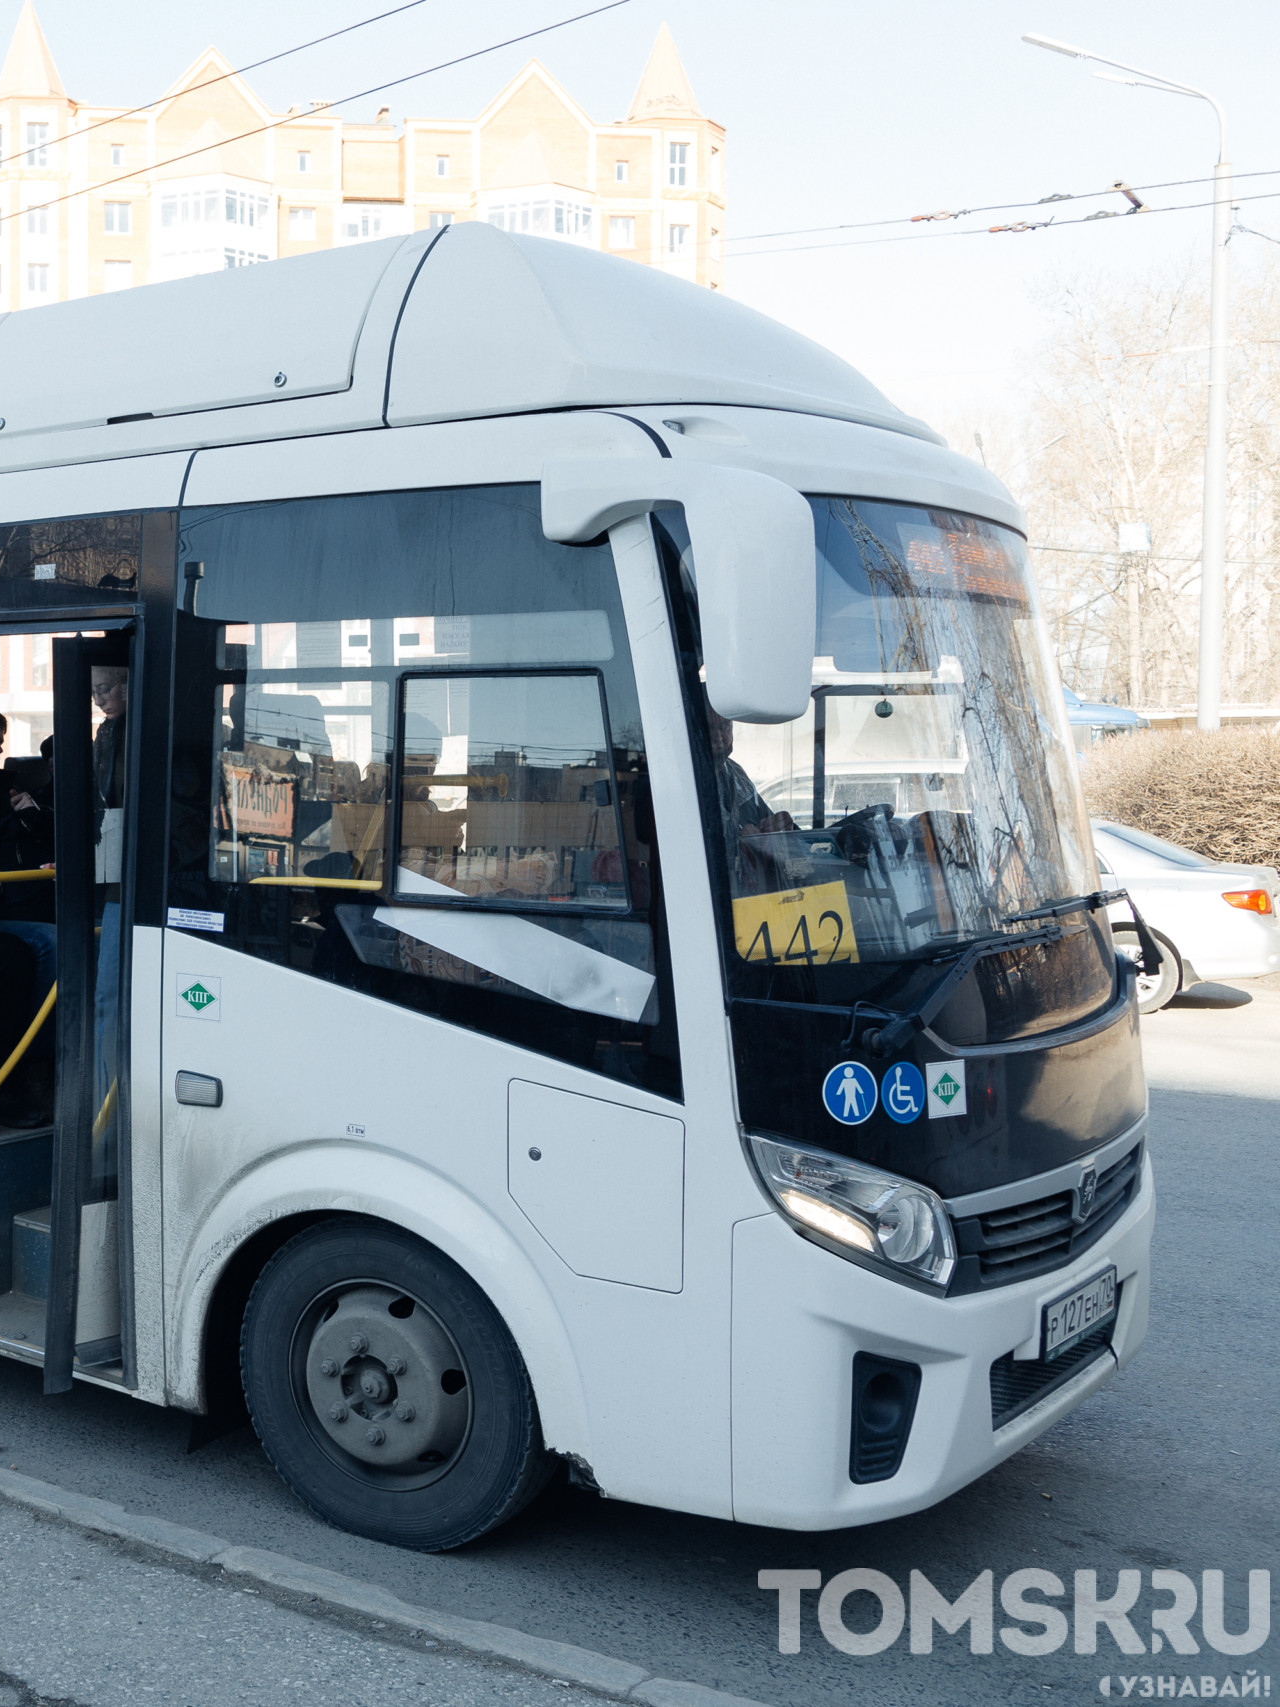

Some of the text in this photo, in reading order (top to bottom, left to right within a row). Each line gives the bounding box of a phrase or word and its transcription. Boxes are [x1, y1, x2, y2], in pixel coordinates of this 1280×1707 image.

[745, 910, 851, 966] 442
[187, 990, 210, 1004] КПГ
[938, 1081, 957, 1097] КПГ
